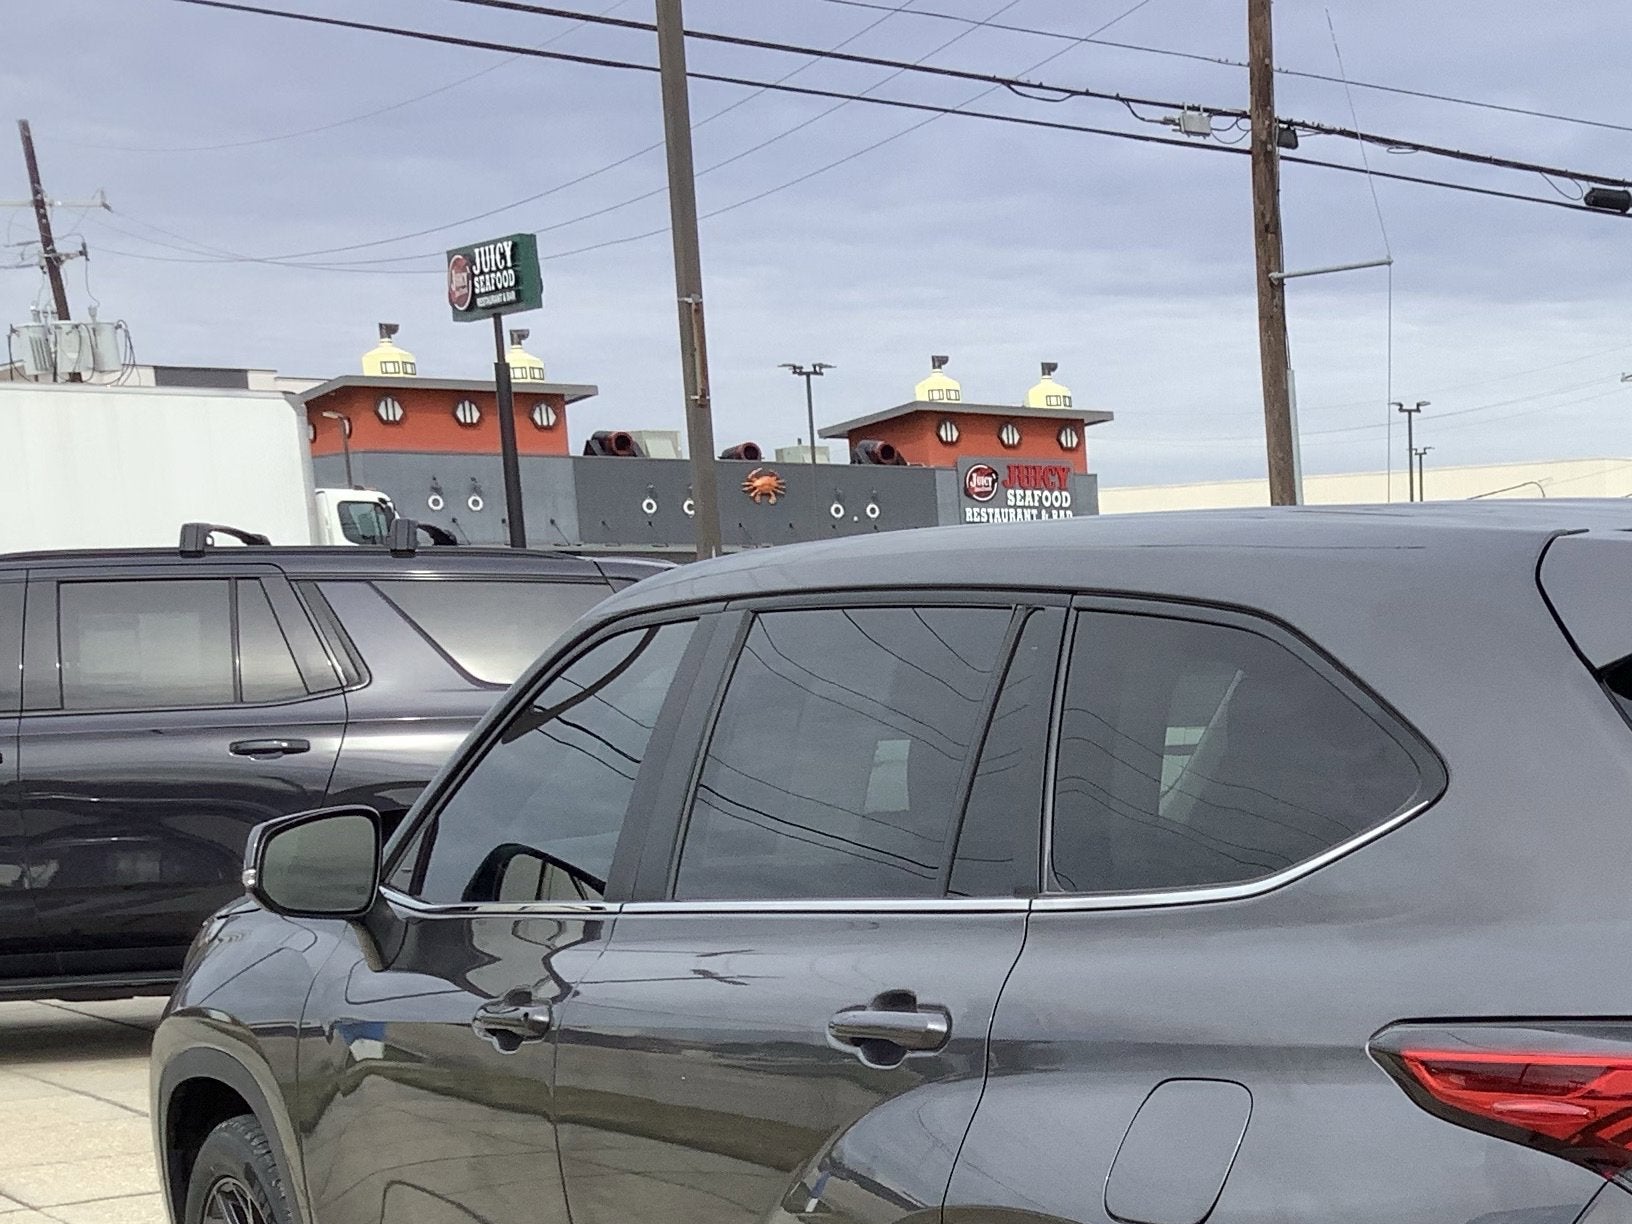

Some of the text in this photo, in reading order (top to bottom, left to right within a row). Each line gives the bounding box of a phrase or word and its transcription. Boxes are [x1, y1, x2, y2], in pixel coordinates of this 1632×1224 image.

[472, 240, 512, 275] JUICY
[474, 269, 515, 294] SEAFOOD
[1003, 464, 1070, 489] JUICY
[1006, 489, 1071, 507] SEAFOOD
[965, 507, 1038, 523] RESTAURANT
